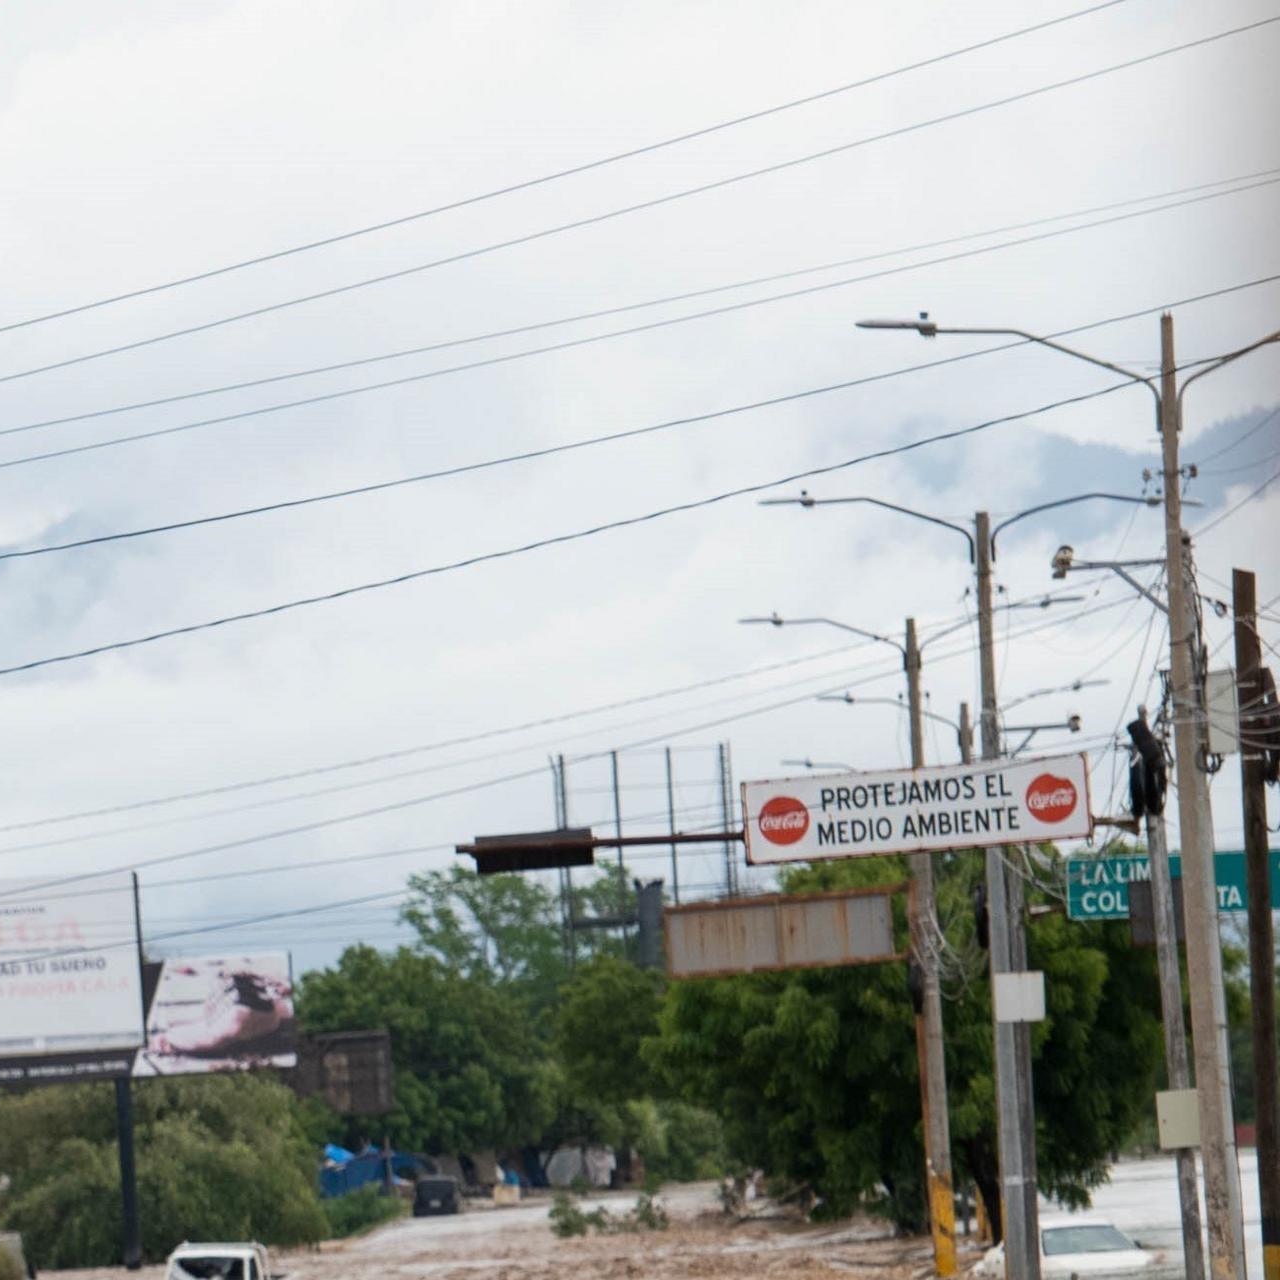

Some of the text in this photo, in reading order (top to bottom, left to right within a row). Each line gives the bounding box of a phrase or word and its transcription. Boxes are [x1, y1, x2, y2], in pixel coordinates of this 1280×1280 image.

[820, 772, 1012, 812] PROTEJAMOS EL
[817, 805, 1020, 847] MEDIO AMBIENTE
[1080, 863, 1109, 887] LA
